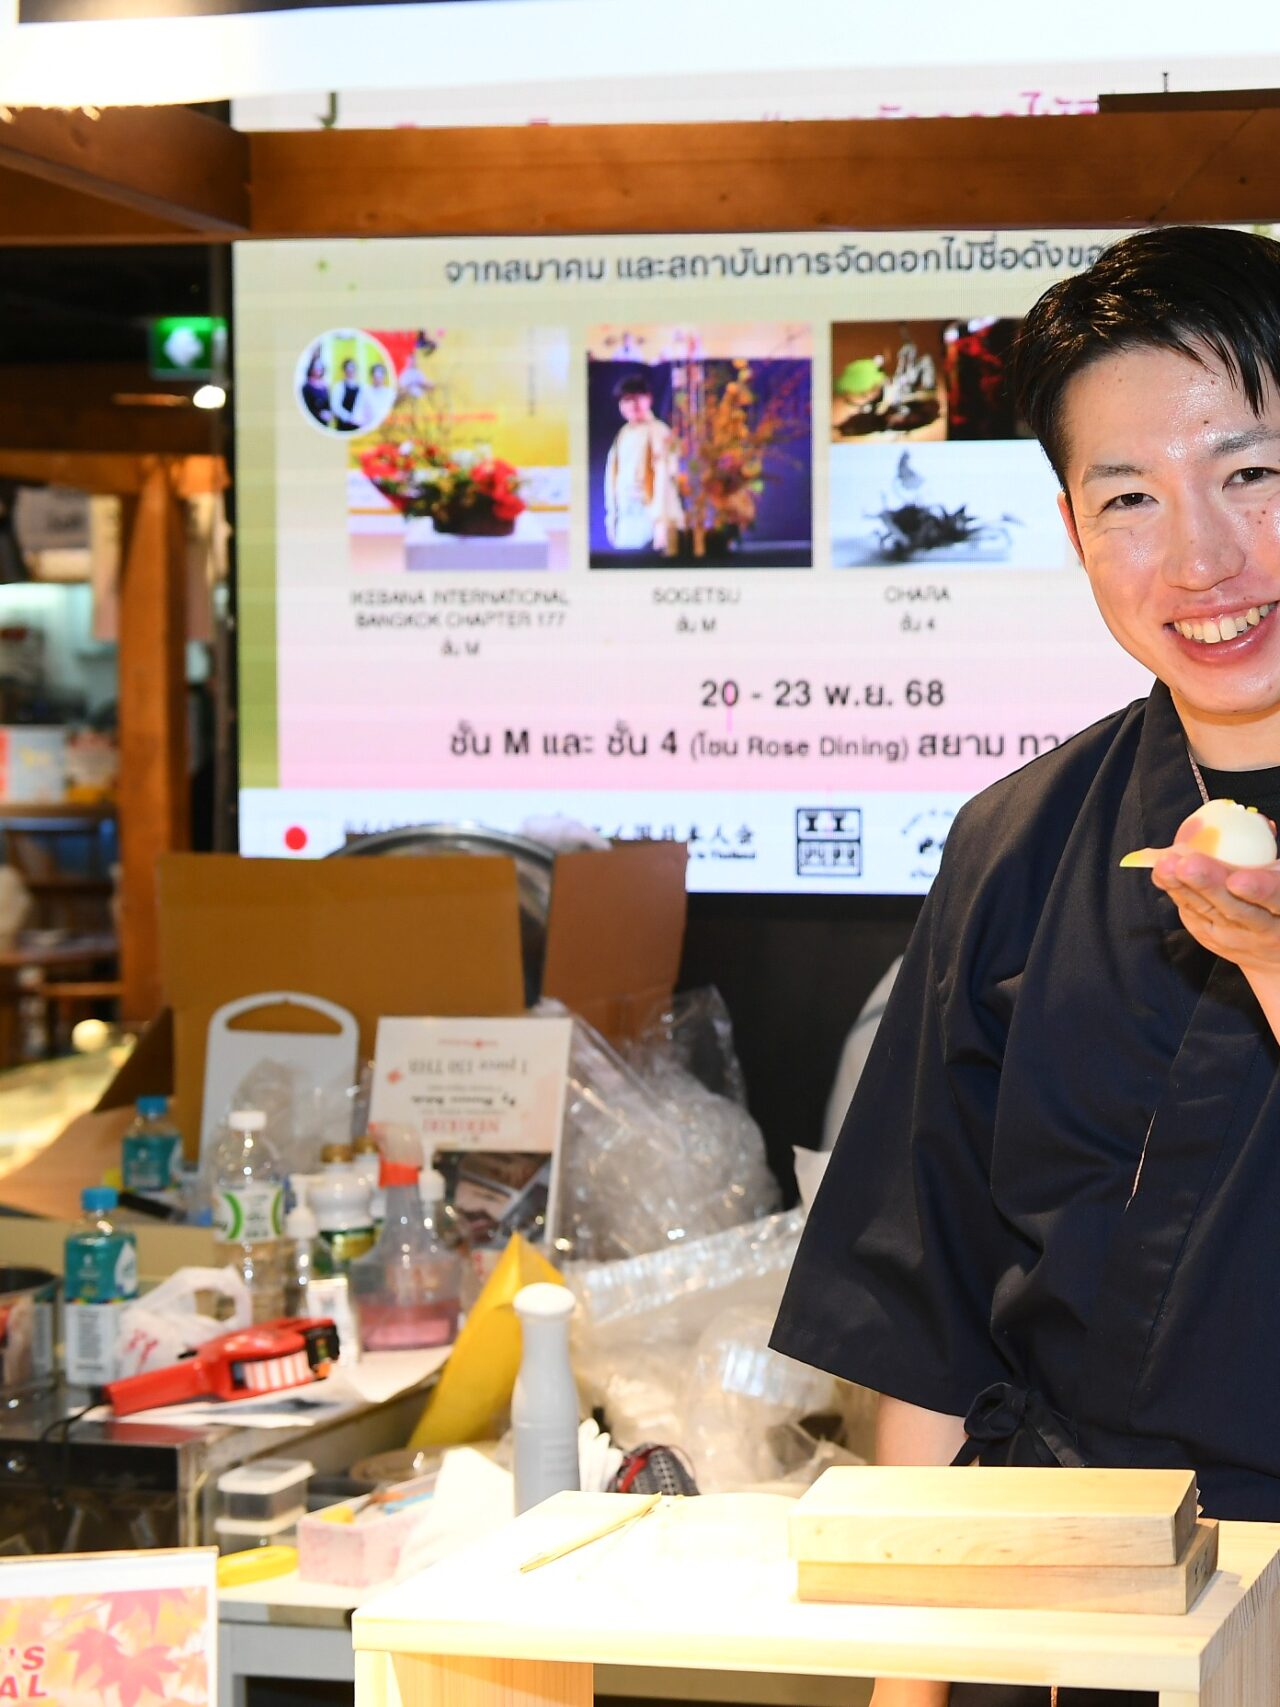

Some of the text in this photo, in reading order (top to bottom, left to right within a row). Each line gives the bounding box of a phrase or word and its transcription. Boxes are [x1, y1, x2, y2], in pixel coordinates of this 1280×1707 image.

[445, 257, 605, 284] จากสมาคม
[433, 588, 570, 605] INTERNATIONAL
[651, 586, 742, 605] SOGETSU
[355, 611, 442, 629] BANGKOK
[445, 611, 532, 628] CHAPTER
[700, 680, 740, 708] 20
[774, 680, 812, 707] 23
[824, 683, 894, 707] พ.ย.
[905, 679, 945, 707] 68
[450, 719, 492, 756] ชั้น
[504, 730, 530, 755] M
[542, 733, 593, 756] และ
[607, 719, 648, 756] ชั้น
[660, 730, 678, 755] 4
[748, 736, 810, 757] Rose
[819, 735, 910, 762] Dining)
[917, 733, 1004, 757] สยาม
